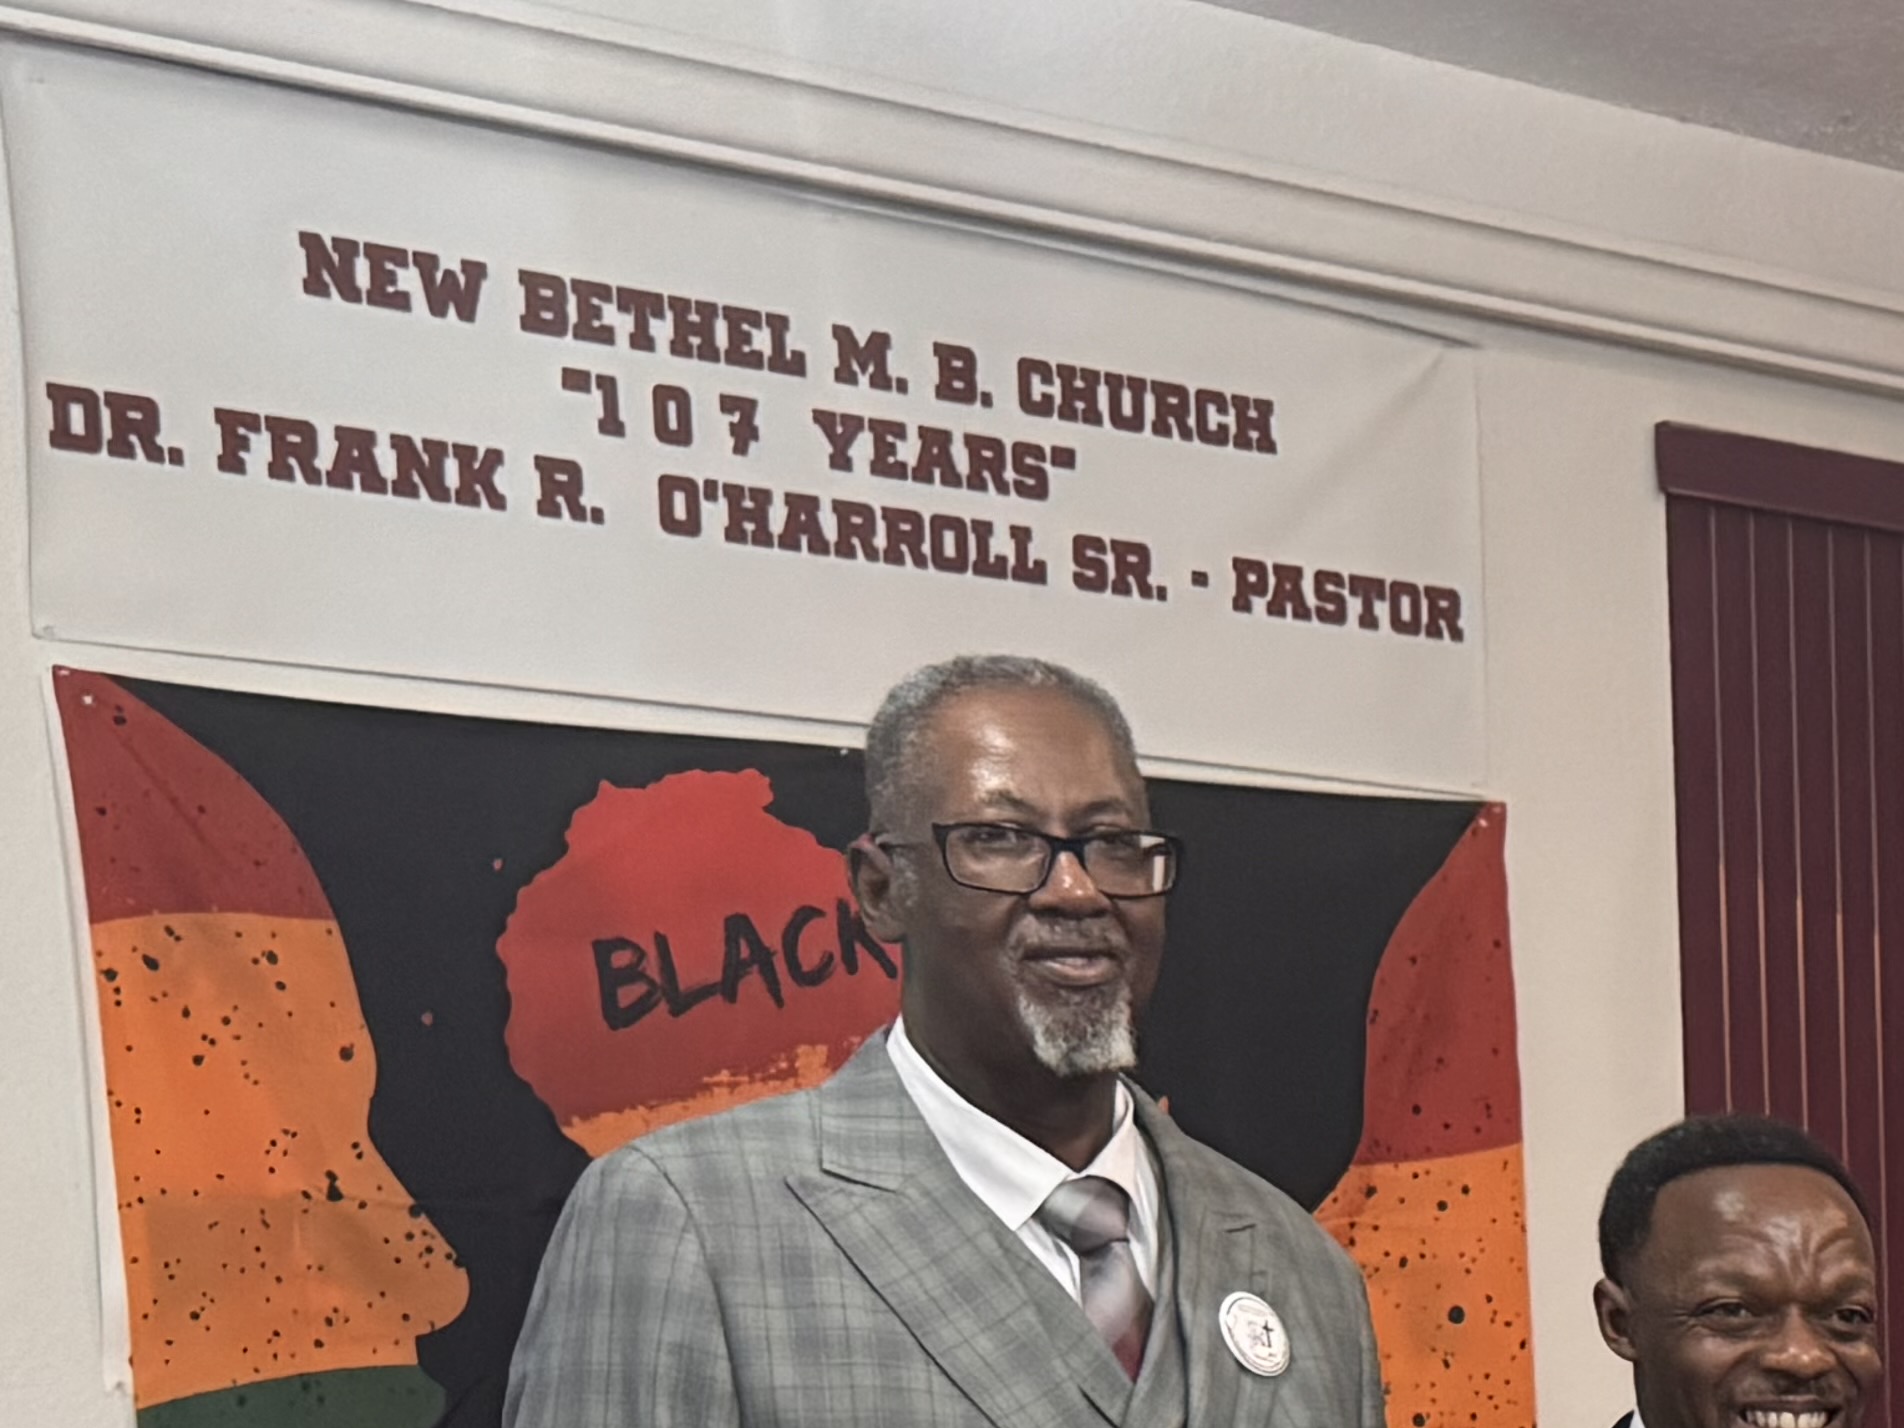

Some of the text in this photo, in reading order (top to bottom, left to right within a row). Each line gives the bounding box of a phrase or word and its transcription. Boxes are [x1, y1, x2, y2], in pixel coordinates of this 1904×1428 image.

[298, 231, 1277, 455] NEW BETHEL M. B. CHURCH
[45, 382, 184, 475] DR.
[214, 407, 507, 511] FRANK
[534, 454, 605, 525] R.
[657, 474, 1048, 586] O'HARROLL
[1072, 534, 1167, 602] SR.
[1232, 556, 1464, 643] PASTOR
[811, 409, 1076, 501] YEARS"
[592, 898, 898, 1031] BLACK
